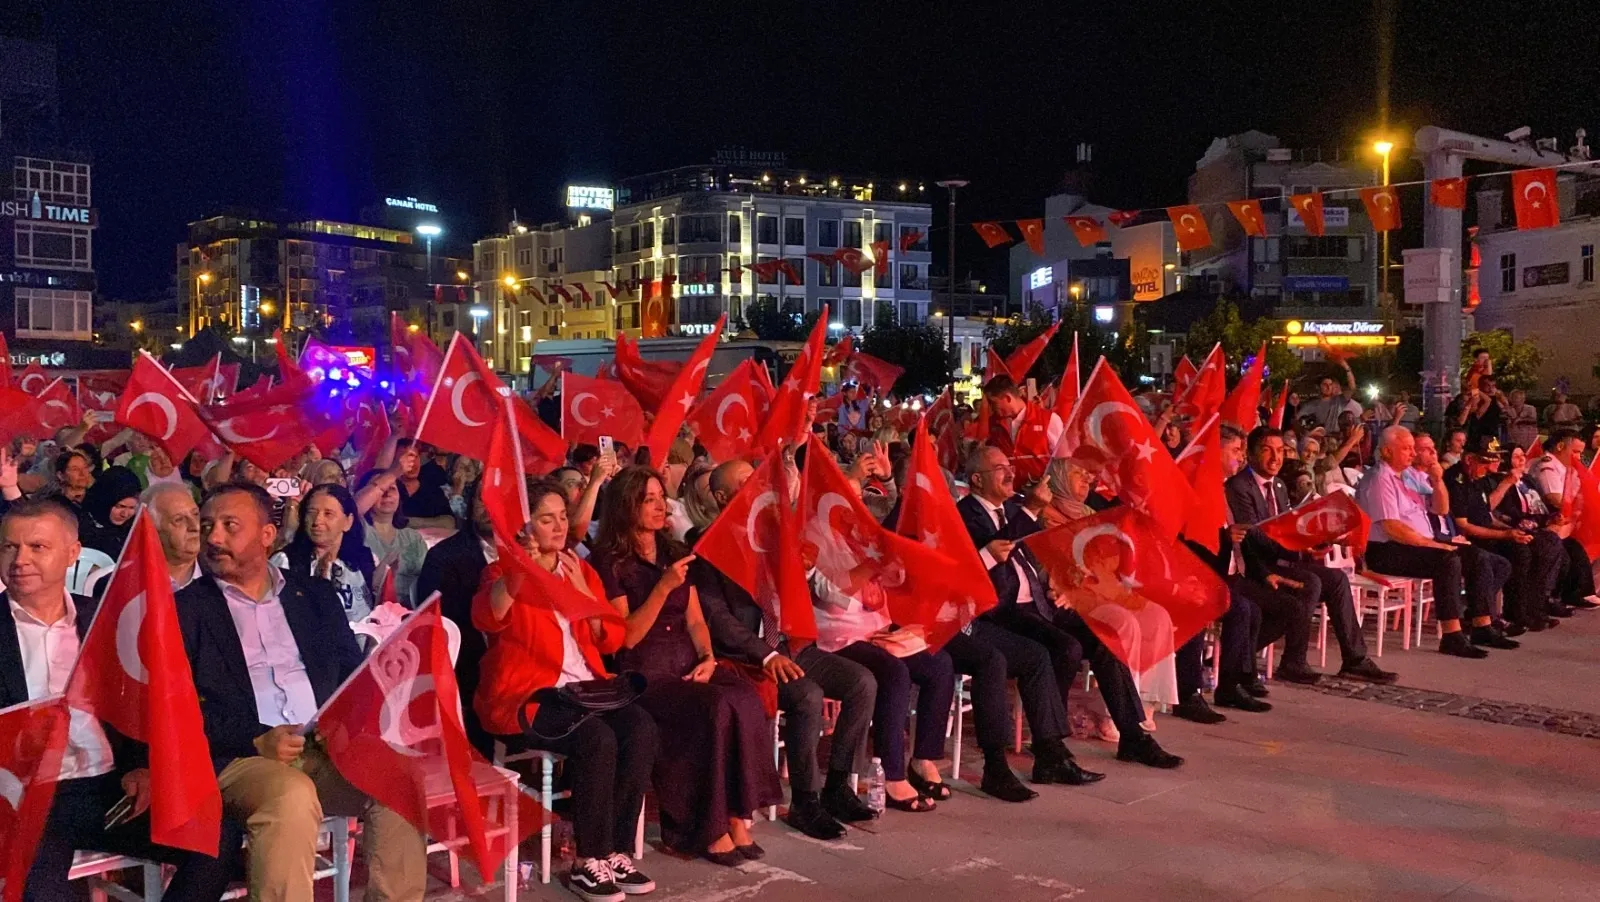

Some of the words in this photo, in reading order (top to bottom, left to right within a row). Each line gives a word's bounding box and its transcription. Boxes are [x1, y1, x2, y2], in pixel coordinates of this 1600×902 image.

[569, 186, 613, 198] HOTEL
[45, 205, 90, 223] TIME
[683, 284, 715, 295] KULE
[1353, 321, 1384, 332] Döner
